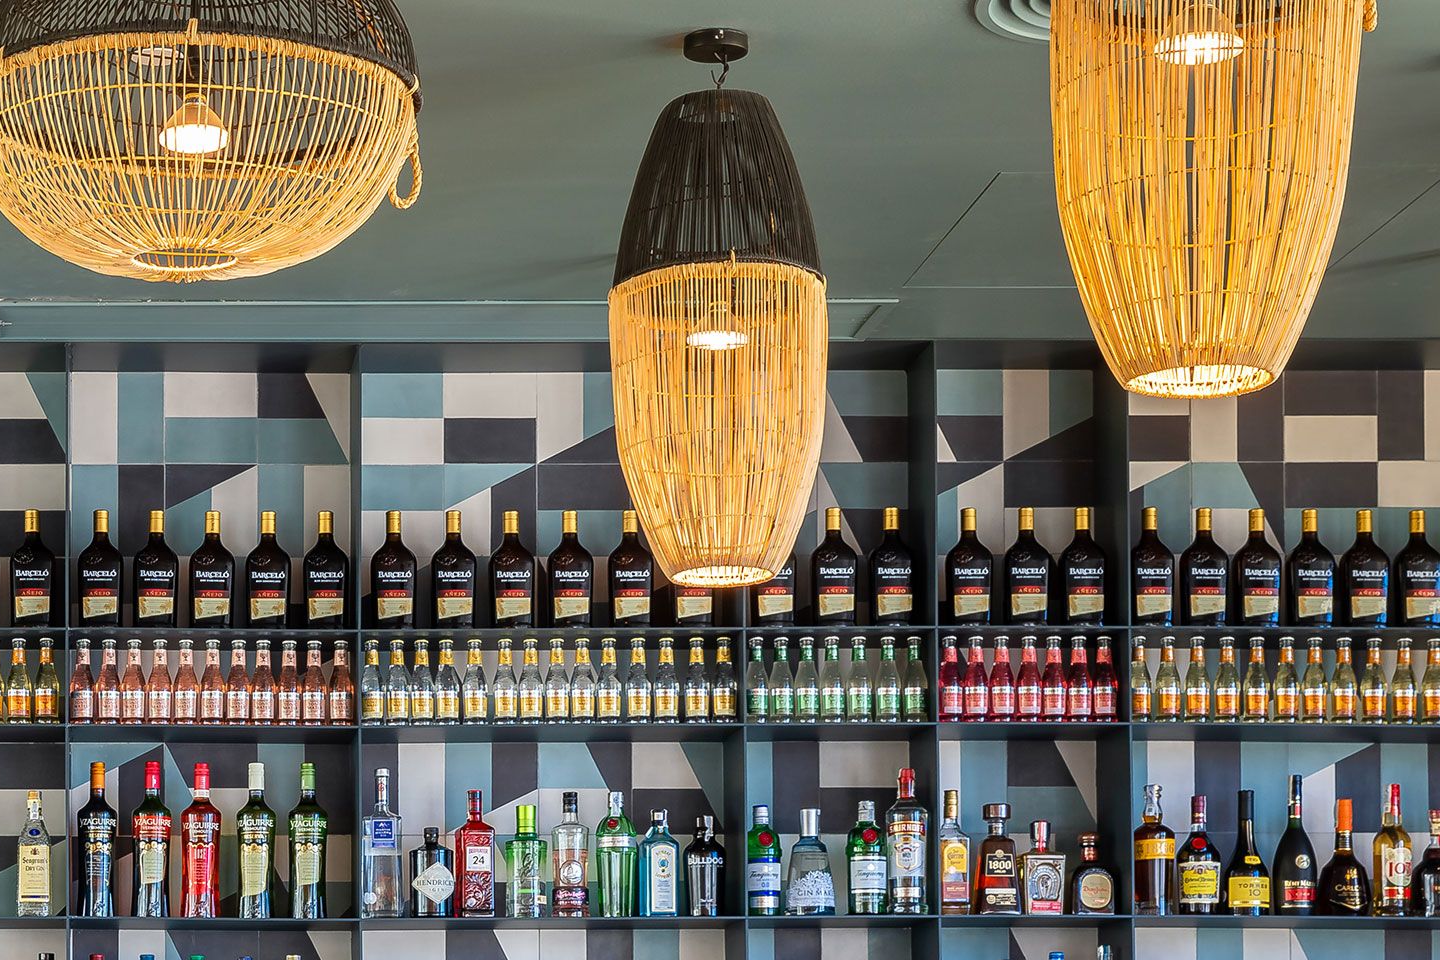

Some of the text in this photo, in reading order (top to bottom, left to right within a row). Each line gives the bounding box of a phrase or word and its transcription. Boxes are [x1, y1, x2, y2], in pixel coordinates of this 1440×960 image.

[15, 568, 49, 577] BARCELÓ
[83, 569, 117, 578] BARCELÓ
[140, 569, 174, 578] BARCELÓ
[195, 570, 229, 579] BARCELÓ
[251, 570, 285, 579] BARCELÓ
[310, 570, 344, 579] BARCELÓ
[378, 570, 412, 579] BARCELÓ
[438, 570, 472, 579] BARCELÓ
[497, 570, 531, 579] BARCELÓ
[555, 569, 589, 578] BARCELÓ
[616, 569, 650, 578] BARCELÓ
[820, 566, 854, 575] BARCELÓ
[878, 566, 912, 575] BARCELÓ
[955, 567, 989, 576] BARCELÓ
[1012, 566, 1046, 575] BARCELÓ
[1070, 566, 1104, 575] BARCELÓ
[1137, 567, 1171, 576] BARCELÓ
[1192, 567, 1226, 576] BARCELÓ
[1245, 568, 1279, 577] BARCELÓ
[1298, 568, 1332, 577] BARCELÓ
[1353, 569, 1387, 578] BARCELÓ
[79, 818, 117, 828] YZAGUIRRE
[134, 818, 172, 828] YZAGUIRRE
[182, 821, 220, 831] YZAGUIRRE
[237, 818, 273, 828] YZAGUIRRE
[290, 818, 327, 828] YZAGUIRRE
[472, 856, 485, 864] 24
[688, 856, 723, 866] BULLDOG
[989, 860, 1012, 870] 1800
[1249, 889, 1261, 897] 10
